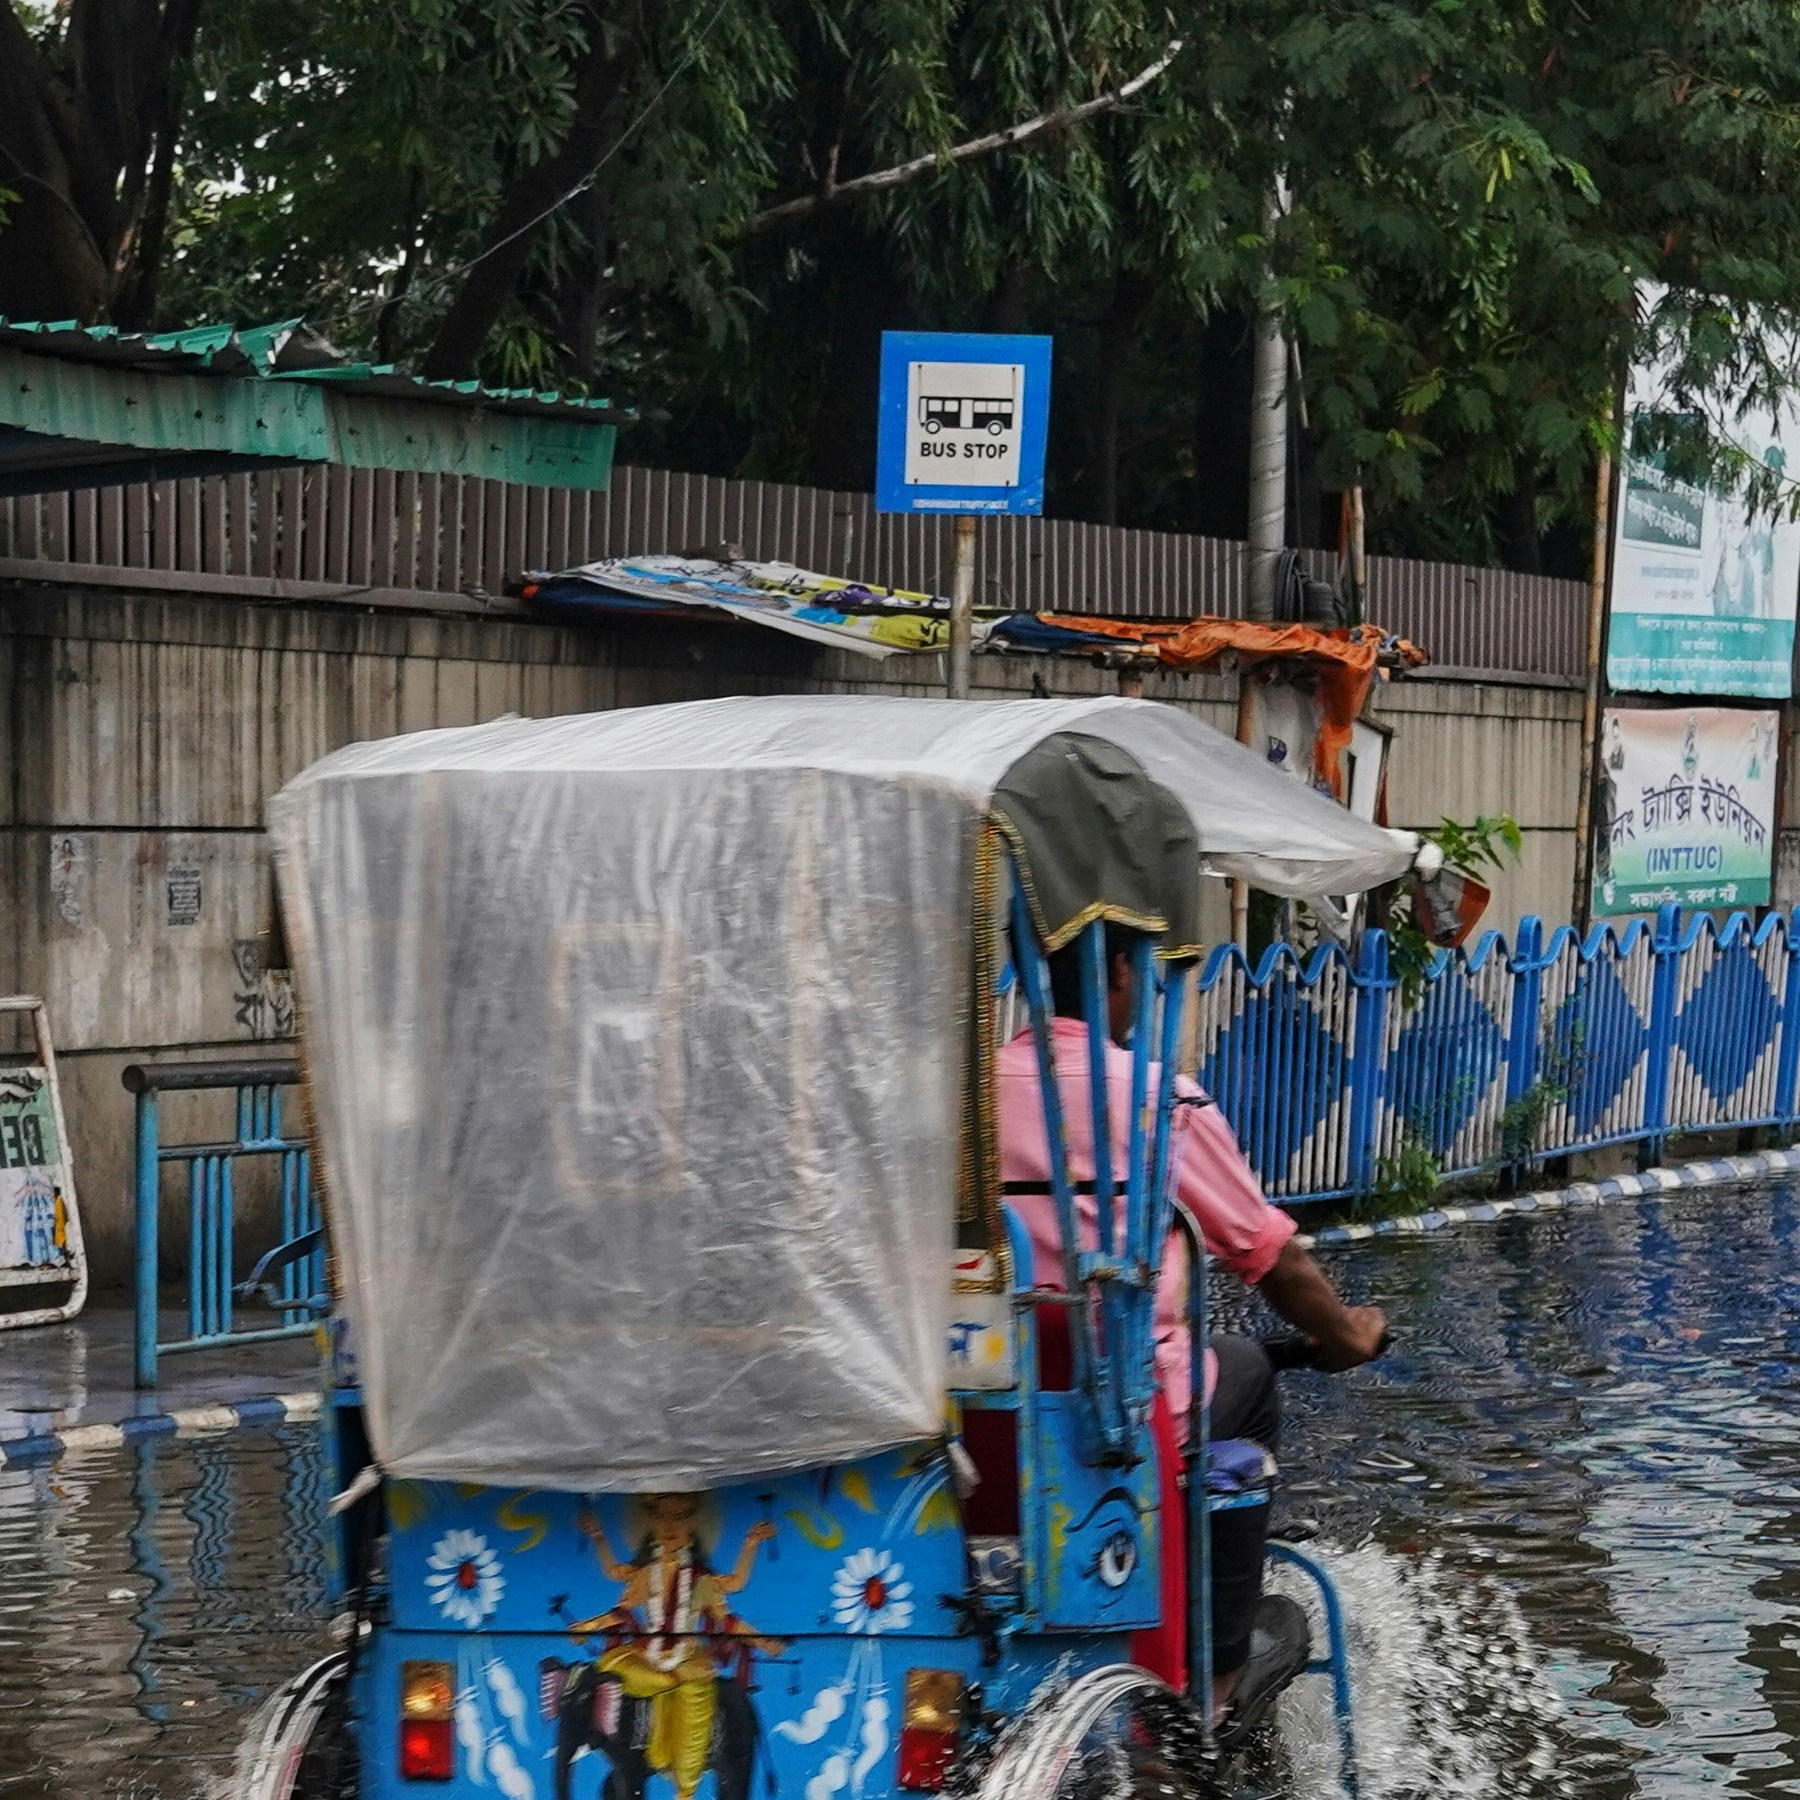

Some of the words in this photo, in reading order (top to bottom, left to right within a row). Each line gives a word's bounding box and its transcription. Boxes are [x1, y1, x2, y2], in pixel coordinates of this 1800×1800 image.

[920, 442, 957, 458] BUS
[963, 443, 1009, 459] STOP
[1646, 845, 1723, 879] (INTTUC)
